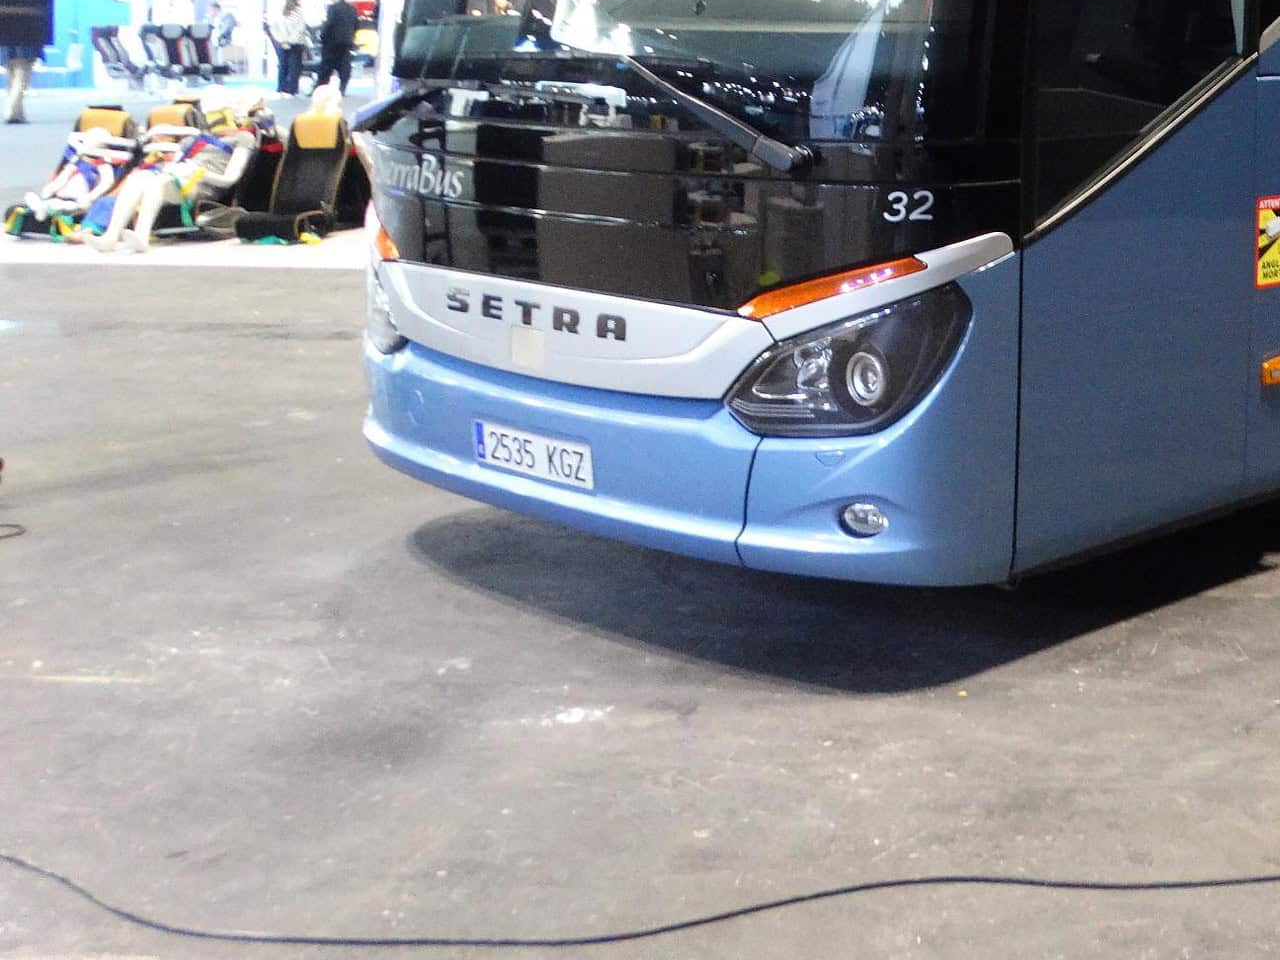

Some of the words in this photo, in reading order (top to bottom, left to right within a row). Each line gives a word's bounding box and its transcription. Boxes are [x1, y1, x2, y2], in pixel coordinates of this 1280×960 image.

[882, 190, 934, 222] 32
[447, 287, 627, 342] SETRA
[489, 431, 536, 469] 2535
[546, 446, 586, 482] KGZ
